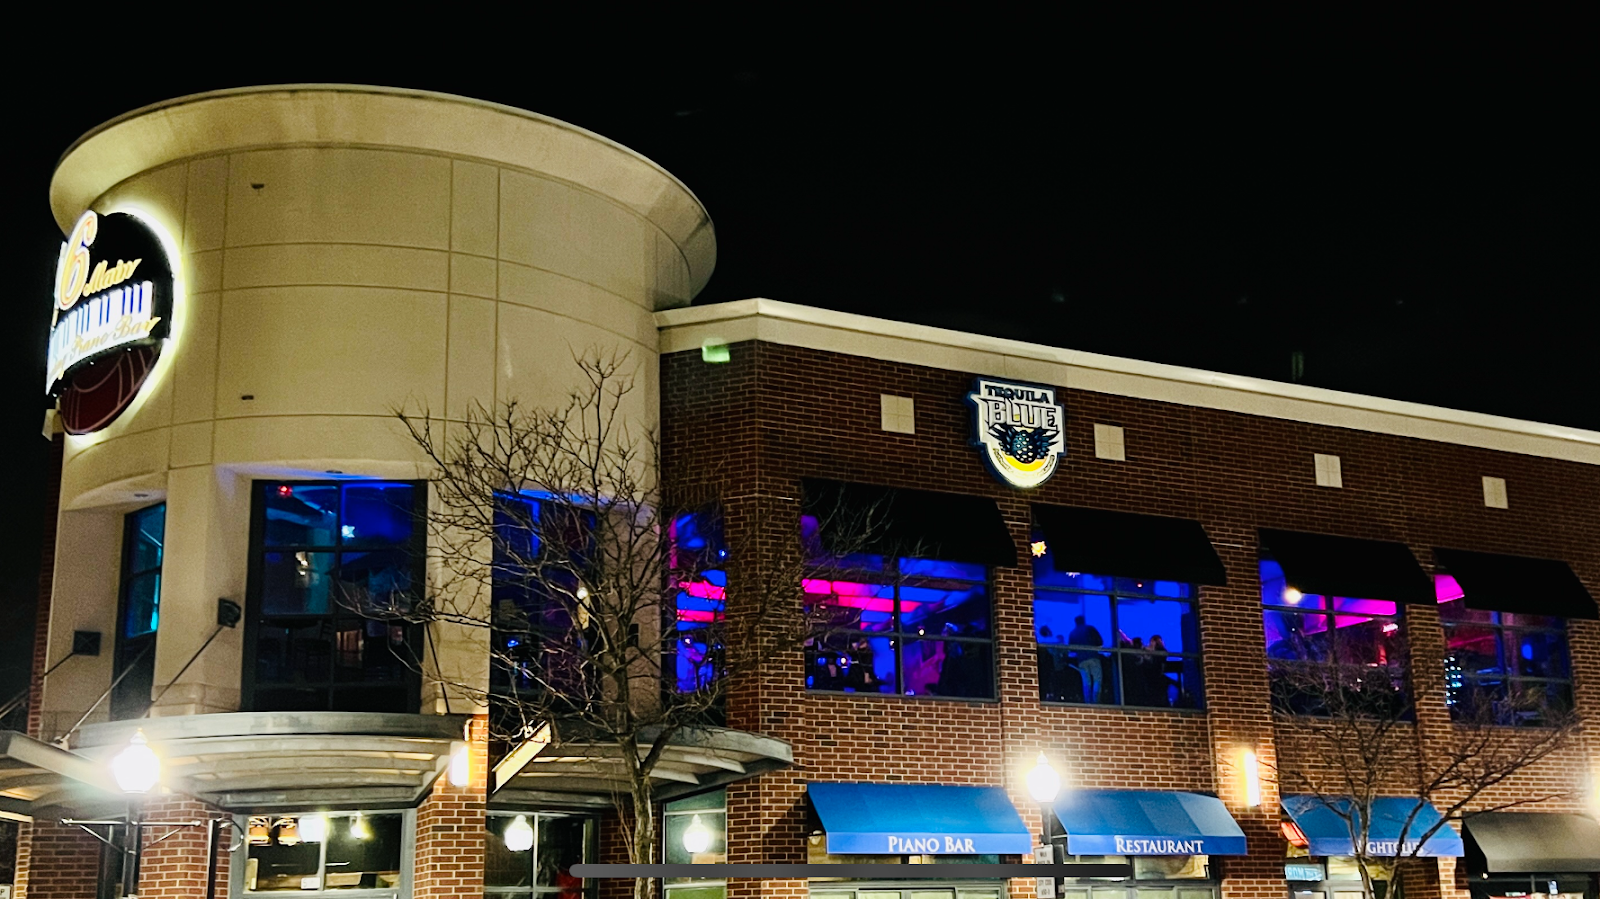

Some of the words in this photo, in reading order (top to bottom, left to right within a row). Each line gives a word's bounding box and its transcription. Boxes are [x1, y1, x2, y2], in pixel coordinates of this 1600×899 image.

[83, 258, 142, 297] Main
[112, 315, 162, 341] Bar
[985, 385, 1049, 403] TEQUILA
[980, 397, 1058, 431] BLUE
[889, 836, 939, 853] PIANO
[945, 837, 975, 853] BAR
[1116, 836, 1204, 854] RESTAURANT
